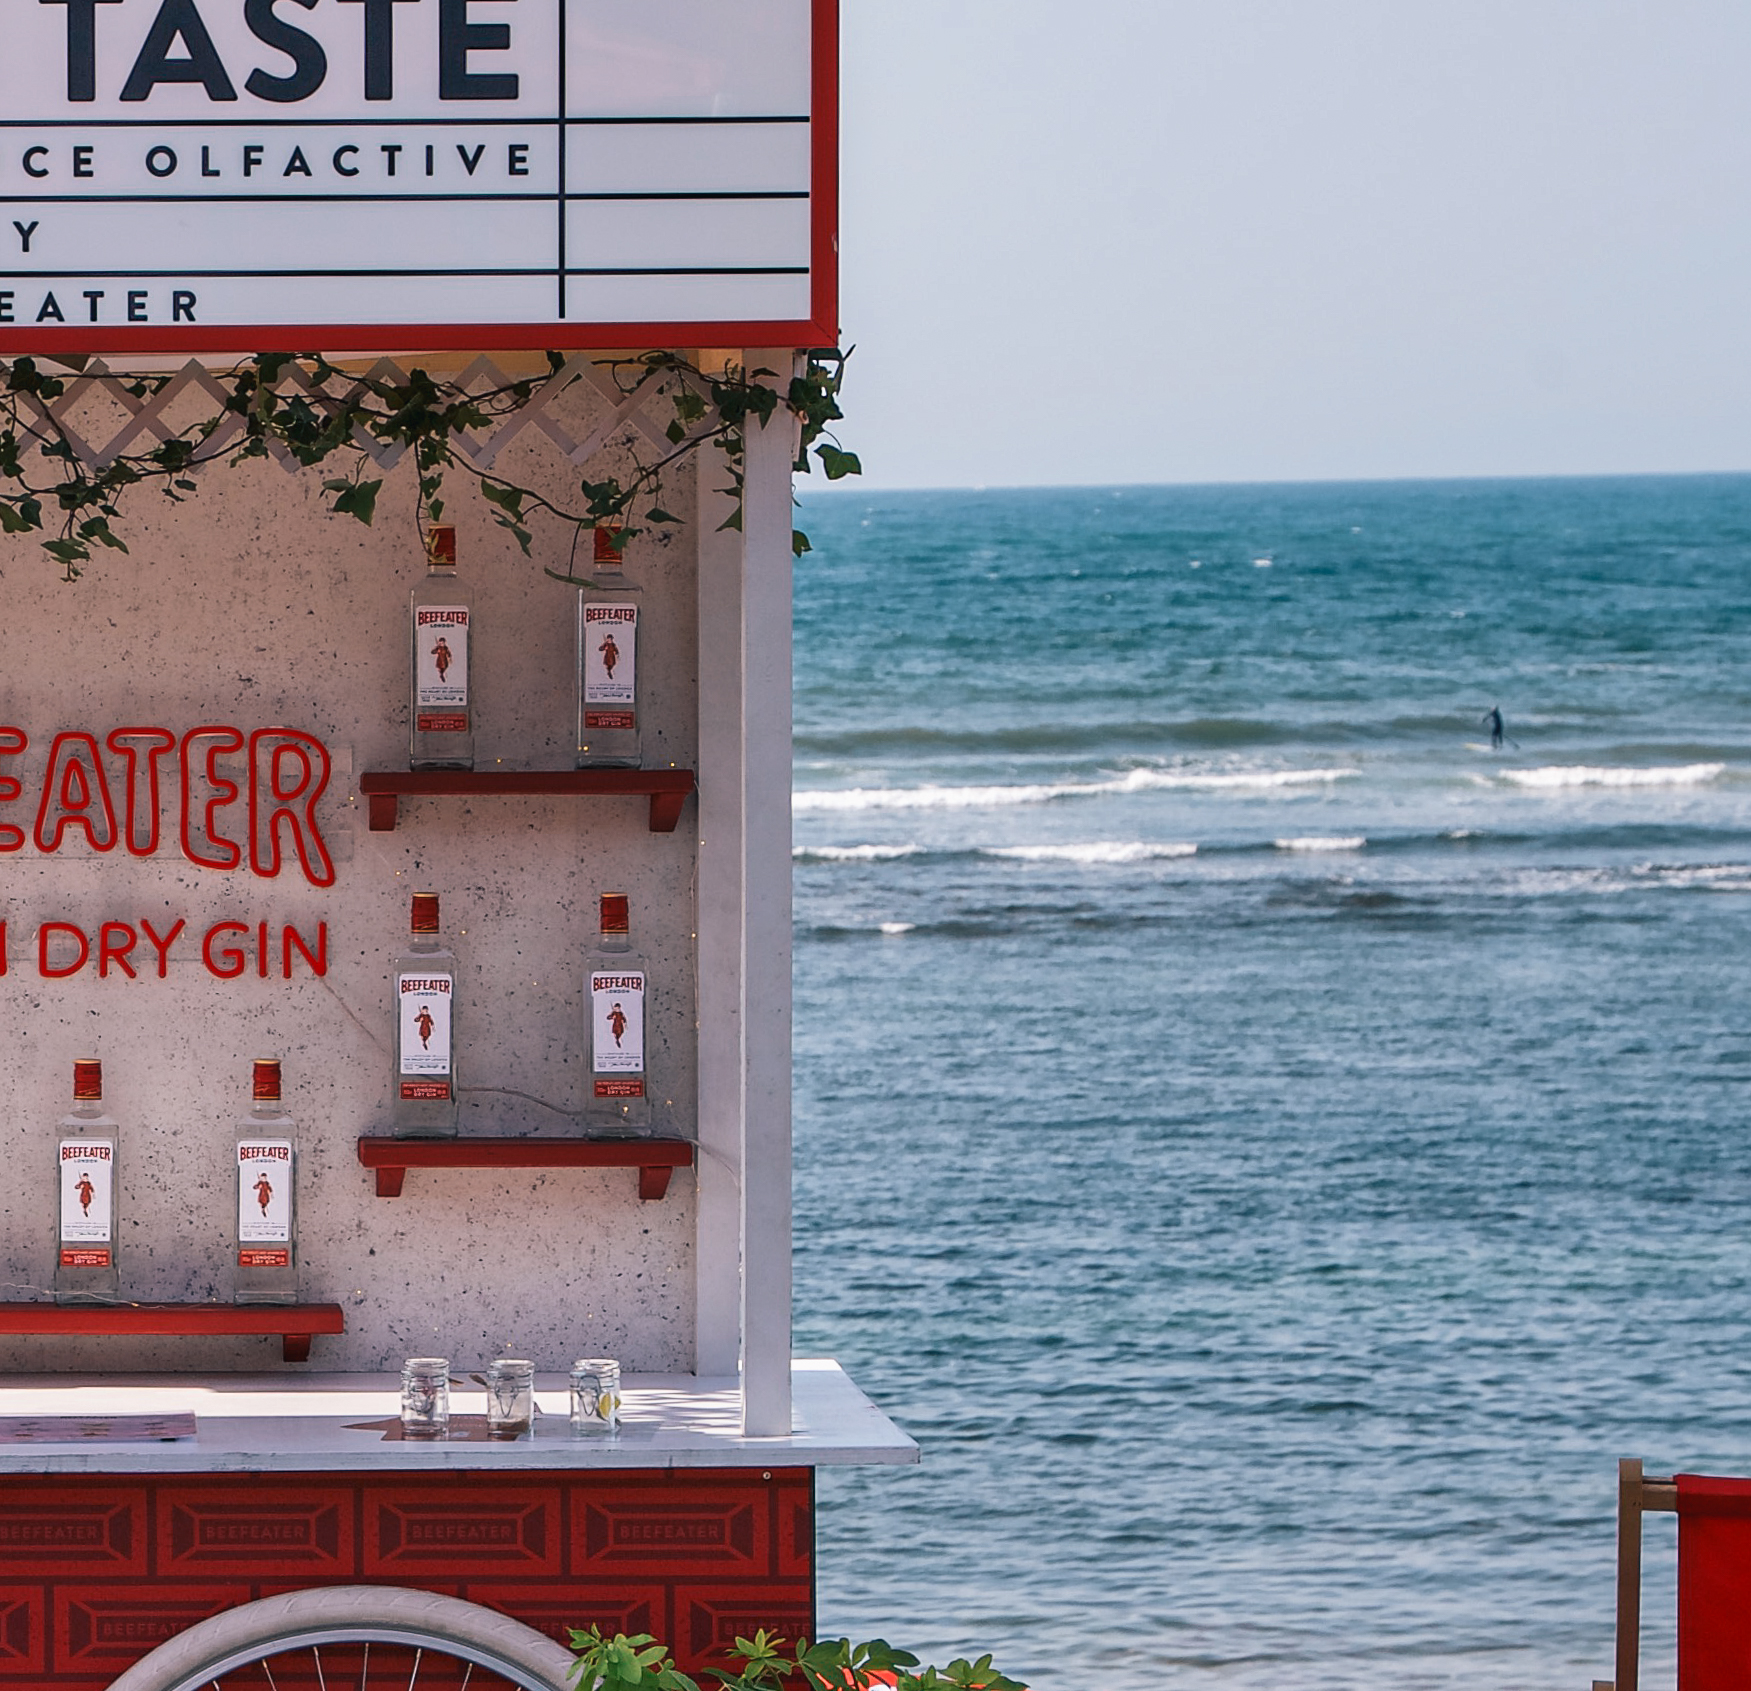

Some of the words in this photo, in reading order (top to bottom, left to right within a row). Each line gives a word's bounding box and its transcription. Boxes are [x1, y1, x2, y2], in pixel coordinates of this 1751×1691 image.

[146, 144, 531, 178] OLFACTIVE
[418, 611, 467, 626] BEEFEATER
[586, 608, 635, 623] BEEFEATER
[37, 919, 186, 979] DRY
[201, 920, 328, 979] GIN
[401, 979, 450, 994] BEEFEATER
[593, 977, 642, 992] BEEFEATER
[62, 1146, 111, 1161] BEEFEATER
[240, 1146, 289, 1161] BEEFEATER
[0, 1524, 99, 1539] BEEFEATER
[205, 1524, 305, 1539] BEEFEATER
[412, 1524, 512, 1539] BEEFEATER
[619, 1524, 719, 1539] BEEFEATER
[102, 1621, 189, 1636] BEEFEAT
